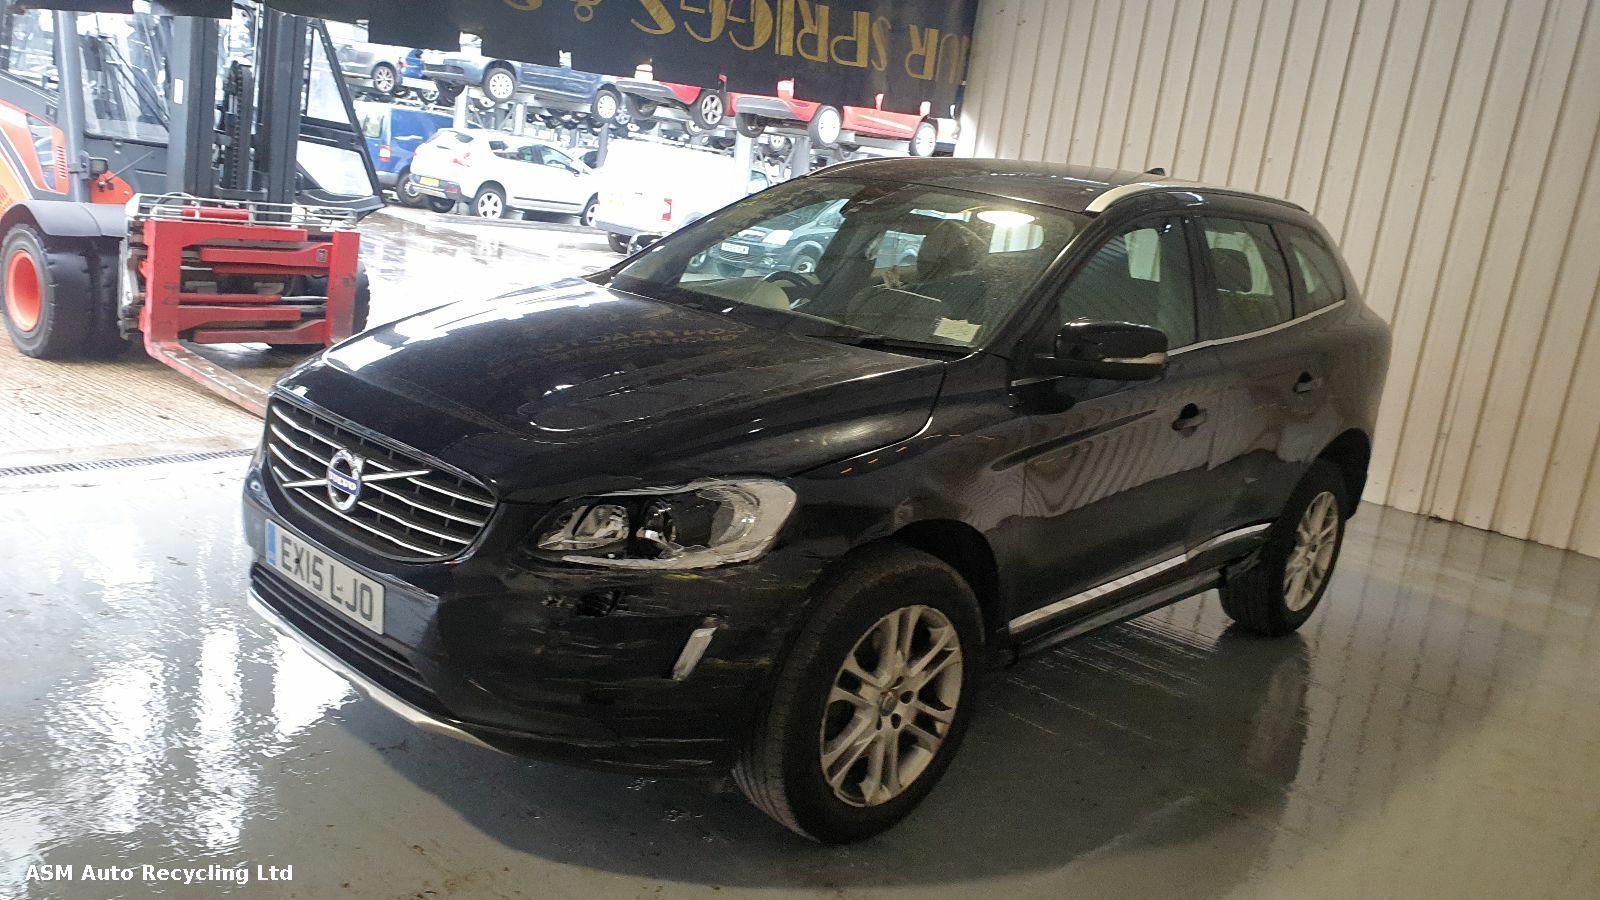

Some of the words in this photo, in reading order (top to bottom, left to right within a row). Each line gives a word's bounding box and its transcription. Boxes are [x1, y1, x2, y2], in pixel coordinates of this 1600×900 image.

[631, 0, 892, 72] SPRIGGS
[905, 25, 969, 85] UR
[281, 536, 323, 591] EX15
[330, 565, 373, 621] LJO
